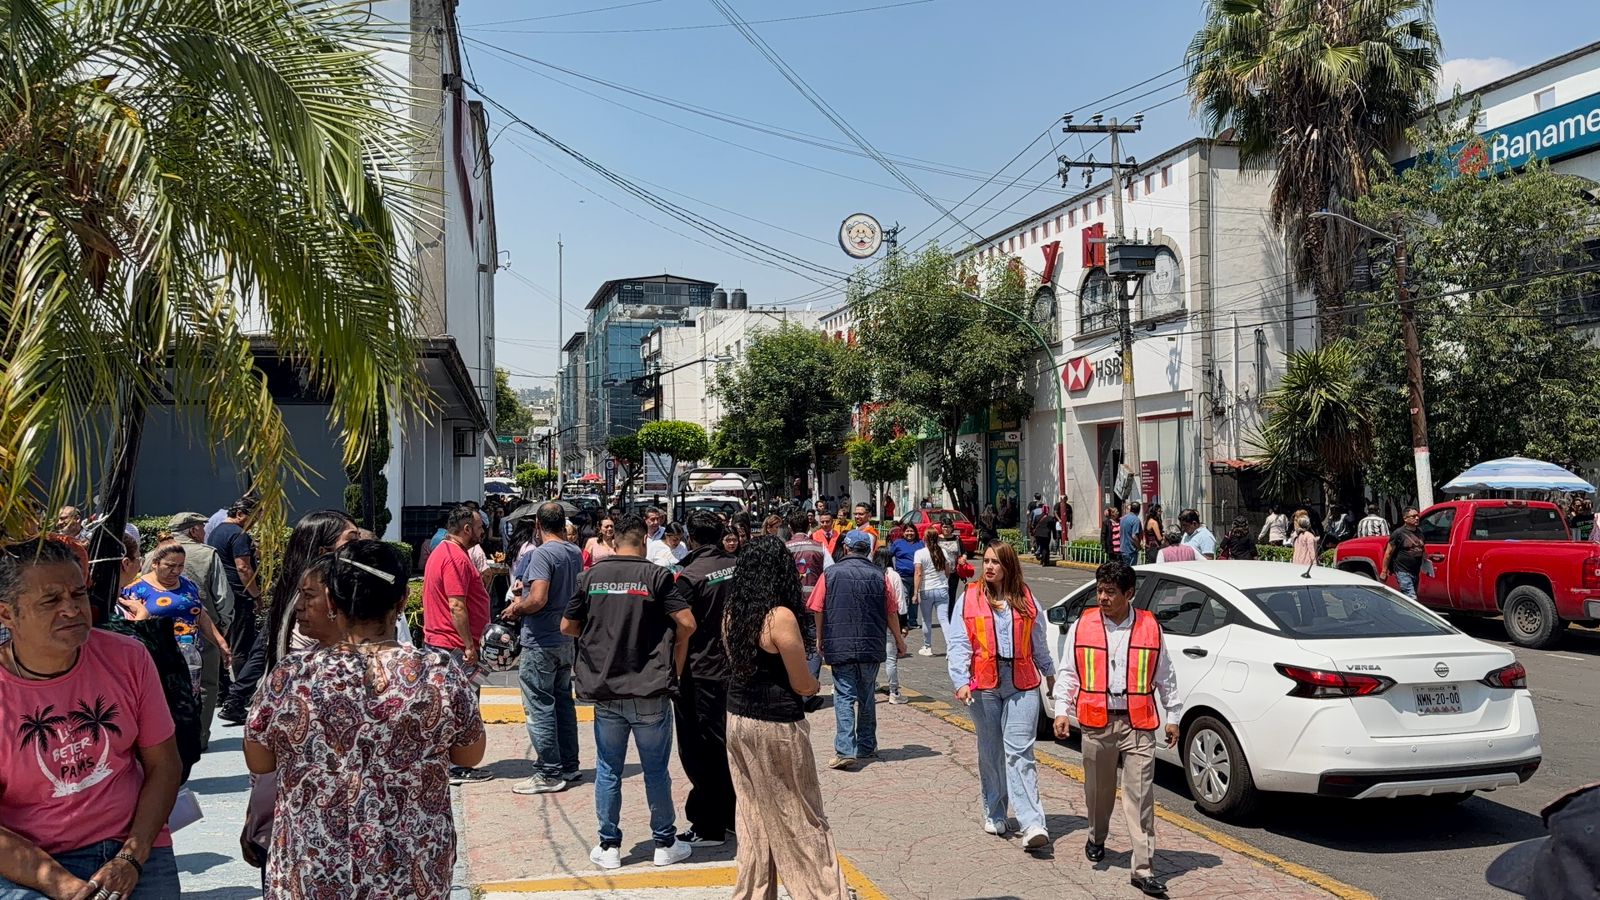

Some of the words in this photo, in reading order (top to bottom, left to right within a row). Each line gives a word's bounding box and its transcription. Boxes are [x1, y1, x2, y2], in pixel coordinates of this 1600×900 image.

[1493, 108, 1600, 164] Baname
[1095, 357, 1122, 379] HSB
[590, 581, 649, 592] TESORERÍA
